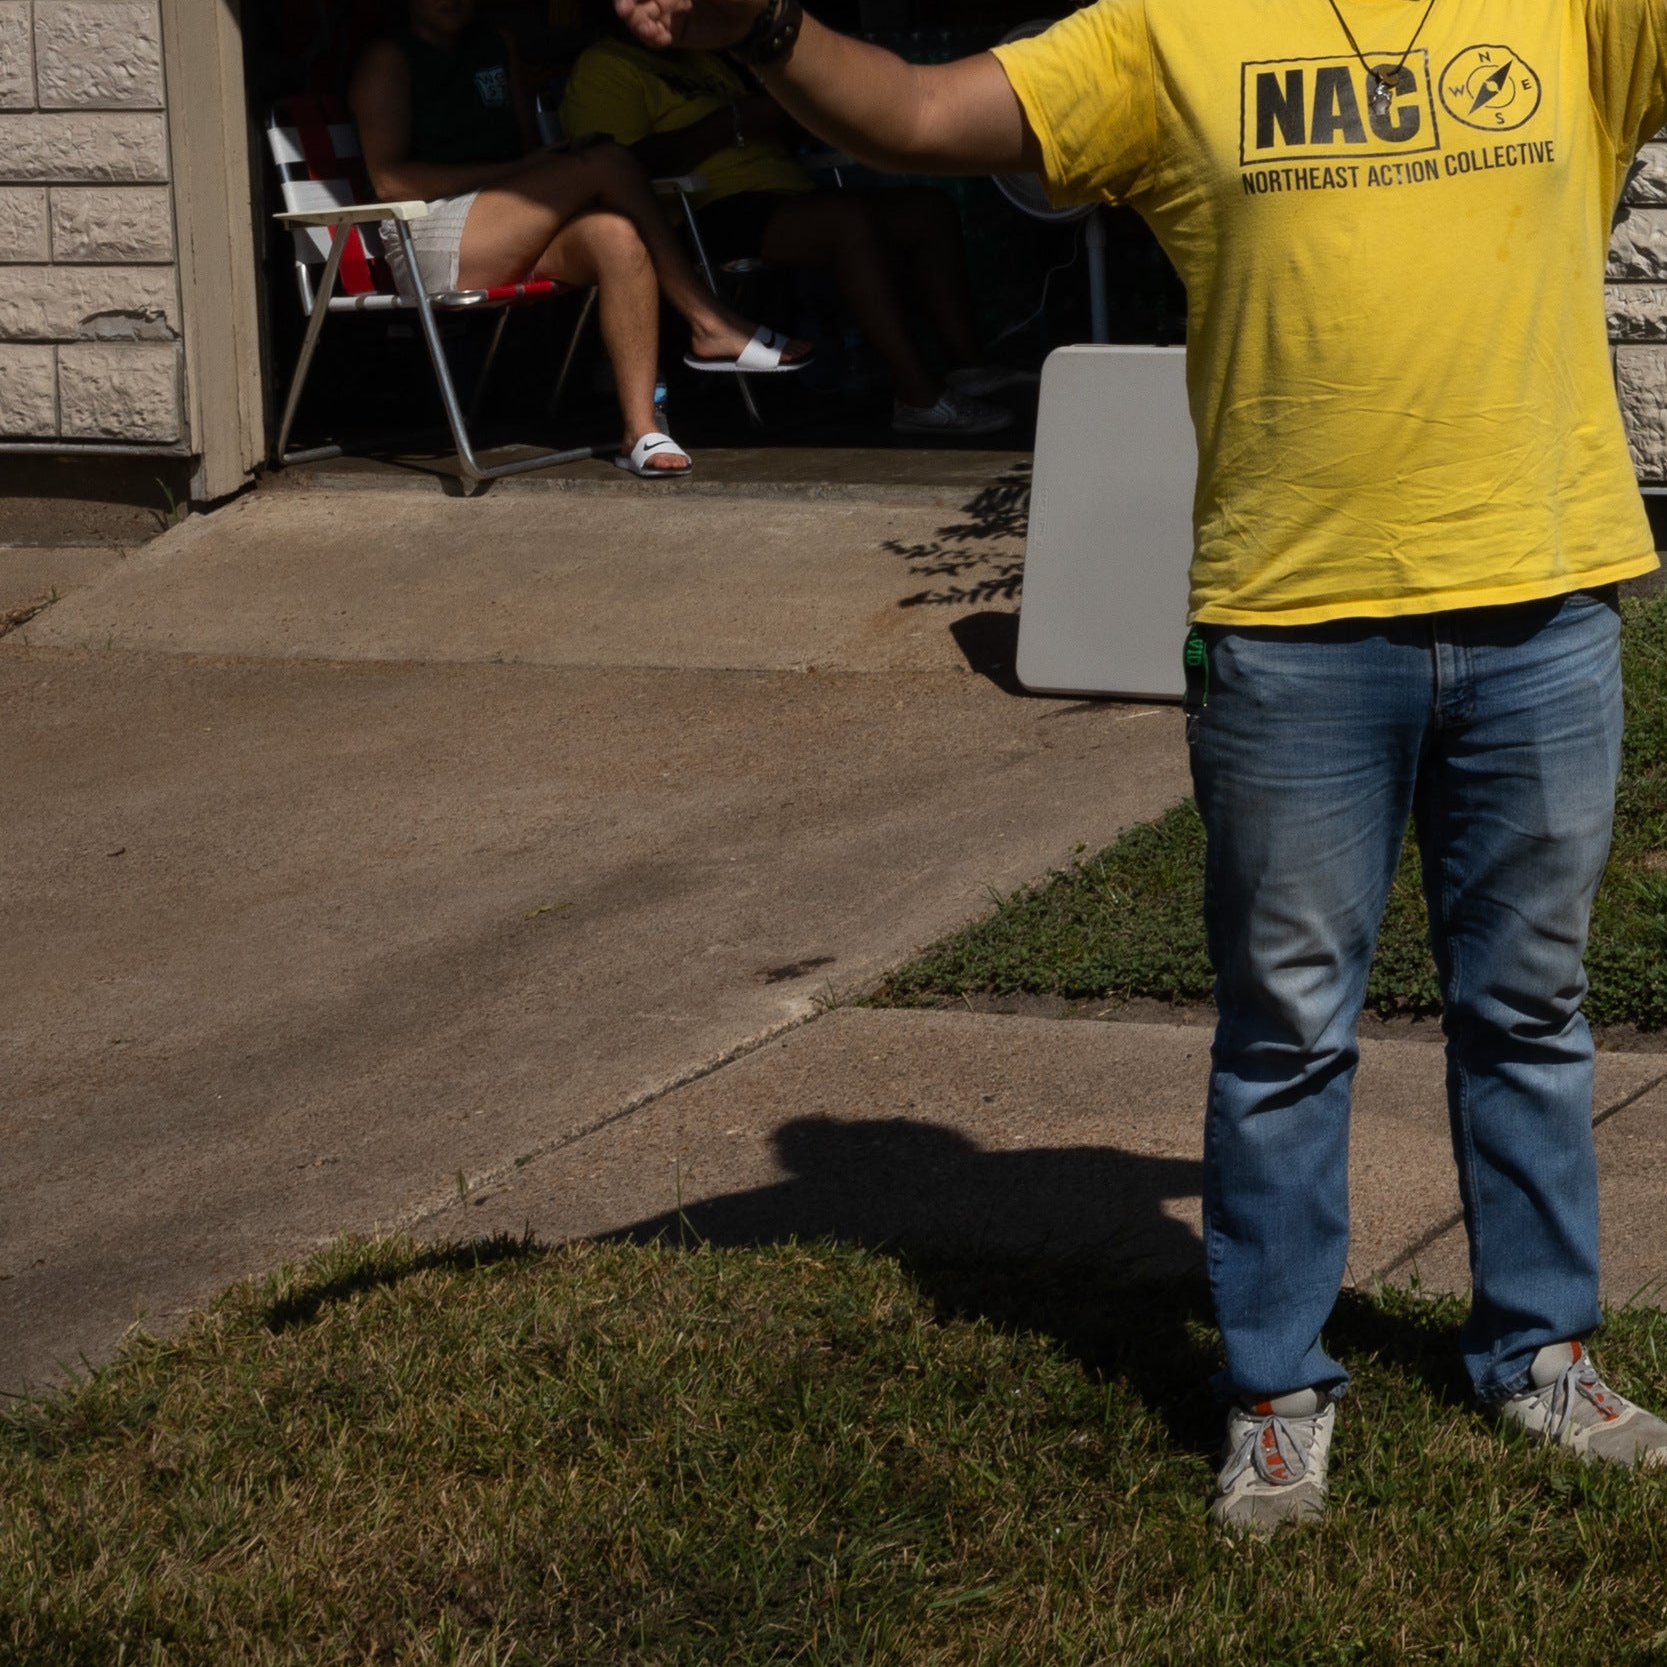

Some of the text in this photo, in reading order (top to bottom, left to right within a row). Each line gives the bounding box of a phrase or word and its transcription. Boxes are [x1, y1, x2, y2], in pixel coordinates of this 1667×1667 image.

[1478, 51, 1491, 63] N
[1448, 84, 1466, 98] W
[1521, 78, 1531, 91] E
[1256, 63, 1421, 149] NAC
[1495, 112, 1504, 125] S
[1242, 140, 1555, 195] NORTHEAST ACTION COLLECTIVE
